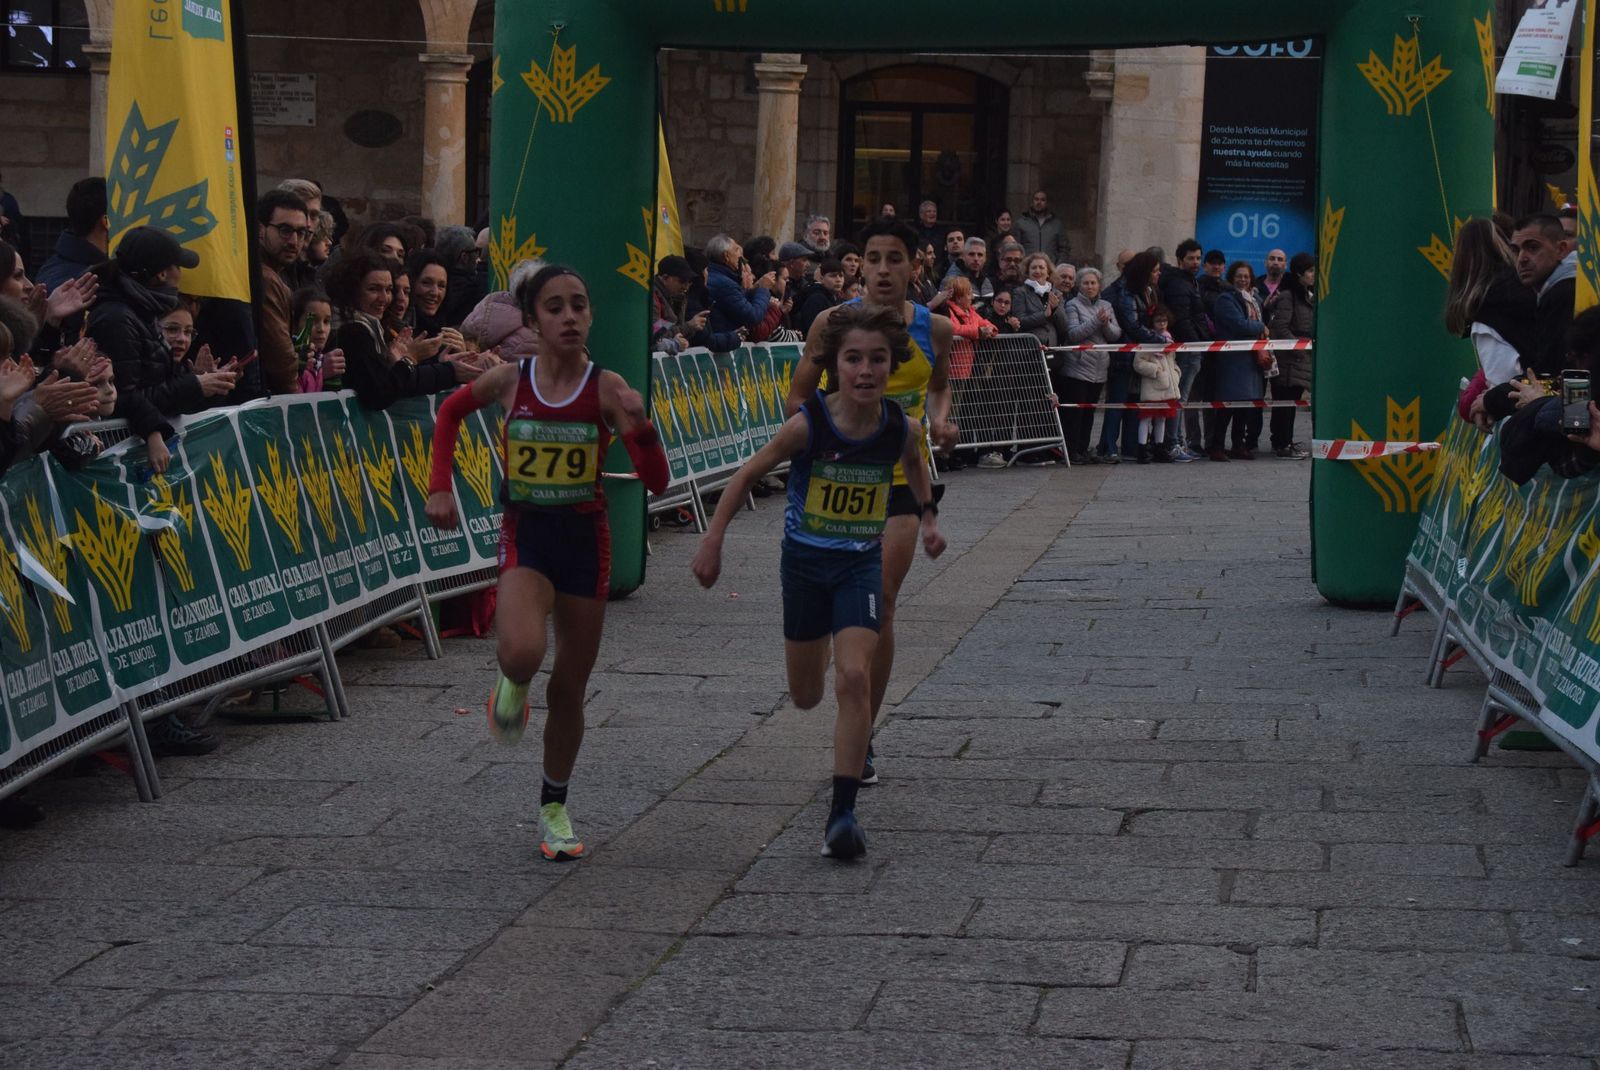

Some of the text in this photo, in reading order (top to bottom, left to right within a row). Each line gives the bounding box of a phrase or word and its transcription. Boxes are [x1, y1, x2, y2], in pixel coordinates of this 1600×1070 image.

[1209, 125, 1235, 135] Desde
[1236, 126, 1244, 135] la
[1270, 127, 1308, 137] Municipal
[1210, 136, 1306, 148] de Zamora te ofrecemos
[1213, 148, 1303, 159] nuestra ayuda cuando
[1225, 159, 1290, 170] más la necesitas
[1228, 212, 1281, 239] 016
[518, 446, 586, 479] 279
[532, 487, 591, 499] CAJA RURAL
[821, 483, 877, 515] 1051
[420, 526, 439, 544] CAJA
[469, 516, 492, 534] CAJA
[825, 523, 880, 535] CAJA RURAL
[430, 541, 461, 557] DE ZAMORA
[482, 534, 493, 546] DE
[282, 560, 323, 588] CAJA RURAL
[228, 573, 283, 609] CAJA RURAL
[242, 600, 276, 623] DE ZAMORA
[103, 614, 163, 654] AJA RURAL
[184, 629, 194, 646] DE
[53, 648, 75, 677] CAJA
[7, 659, 52, 699] CAJA RURAL
[65, 667, 100, 694] DE ZAMORA
[1557, 675, 1586, 705] ZAMORA
